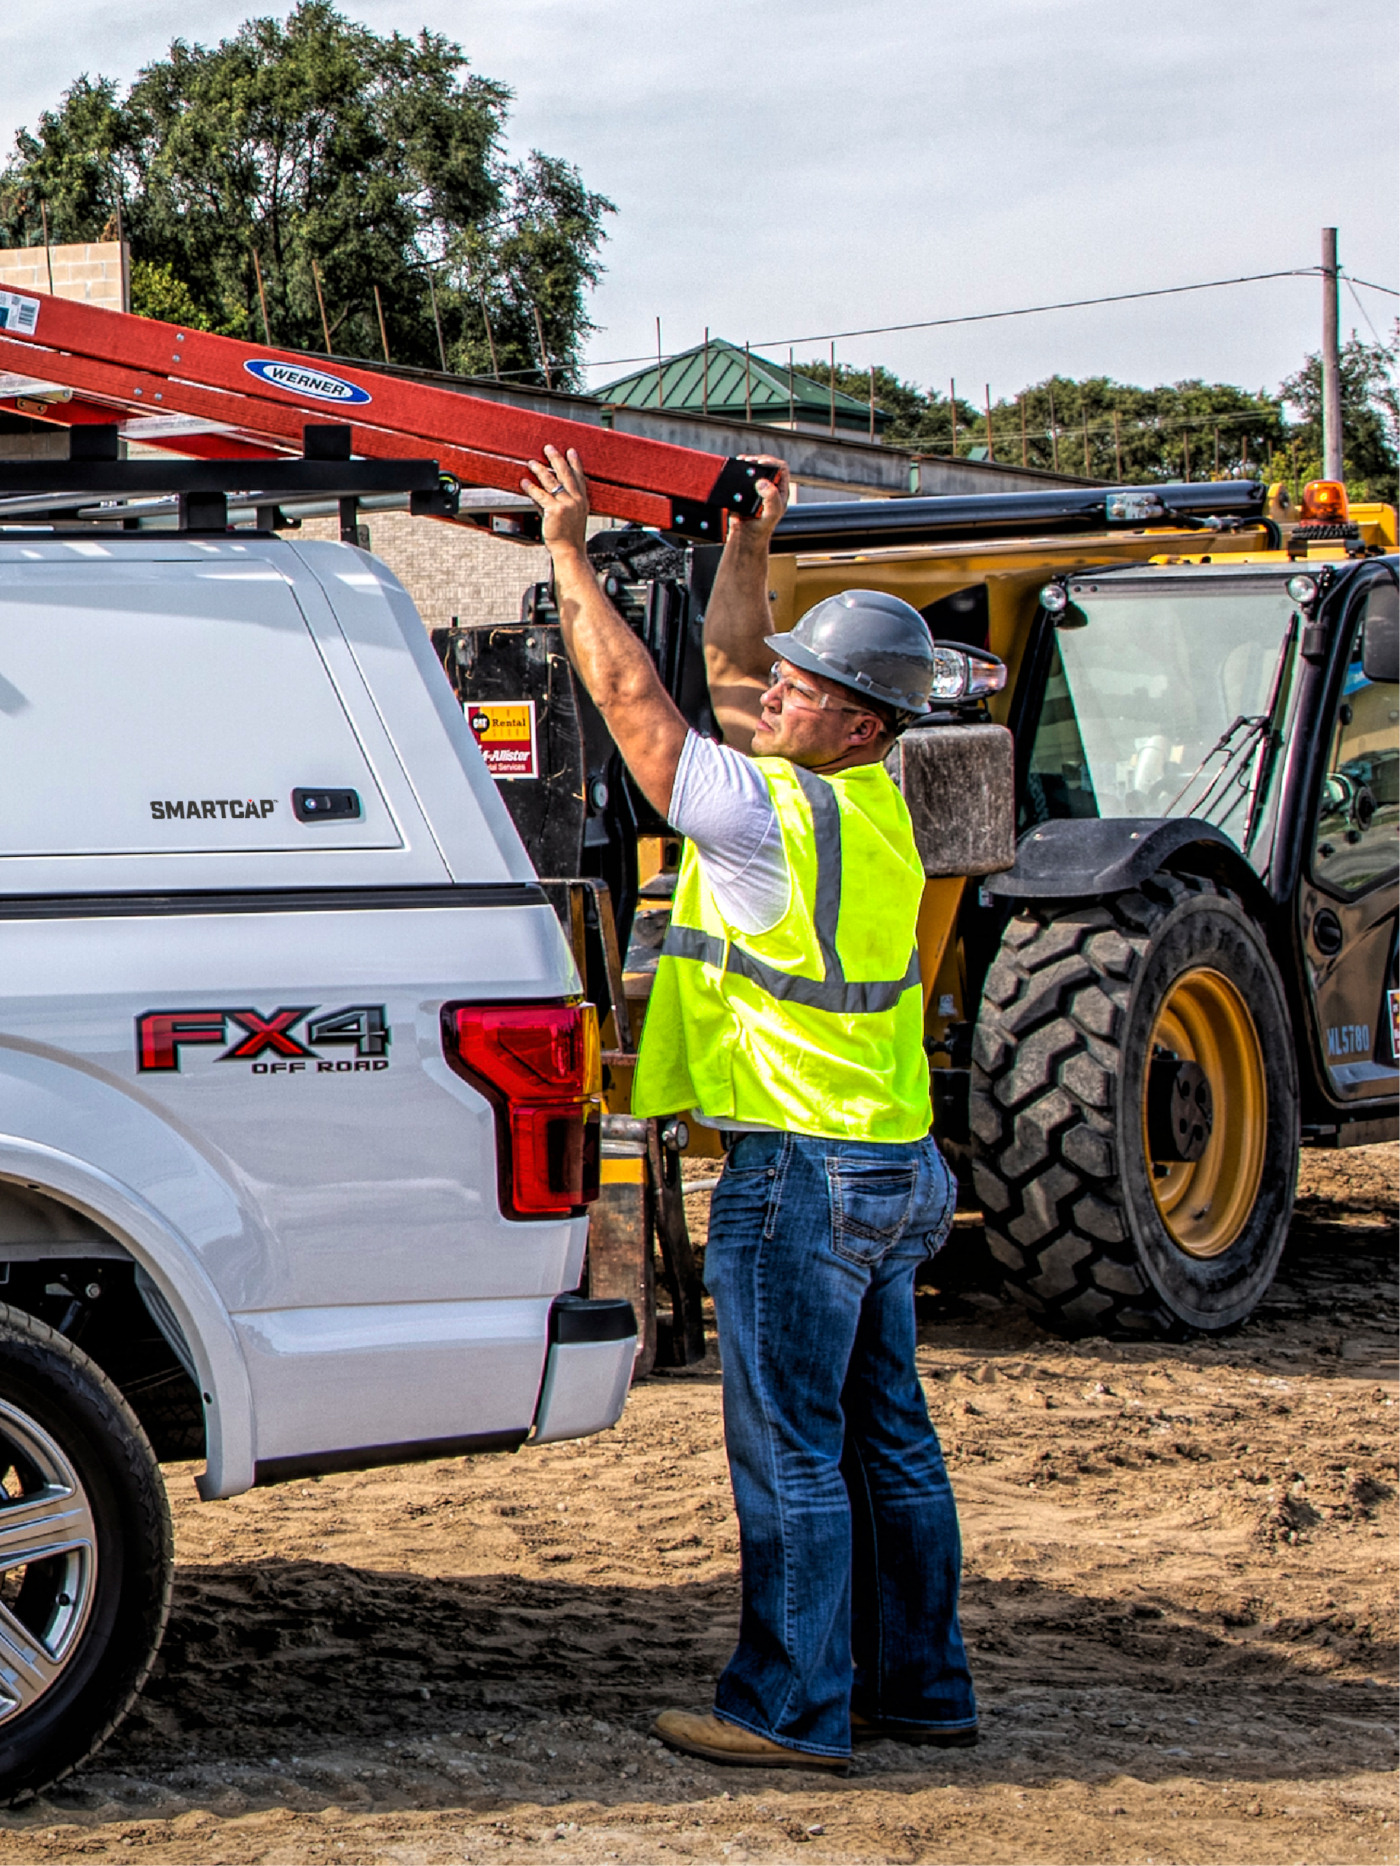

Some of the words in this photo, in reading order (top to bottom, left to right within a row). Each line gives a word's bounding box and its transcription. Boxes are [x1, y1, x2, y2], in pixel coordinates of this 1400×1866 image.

[272, 367, 346, 396] WERNER
[492, 718, 526, 727] Rental
[497, 763, 526, 771] Services
[134, 1003, 392, 1074] FX4
[251, 1061, 306, 1074] OFF
[316, 1060, 390, 1074] ROAD
